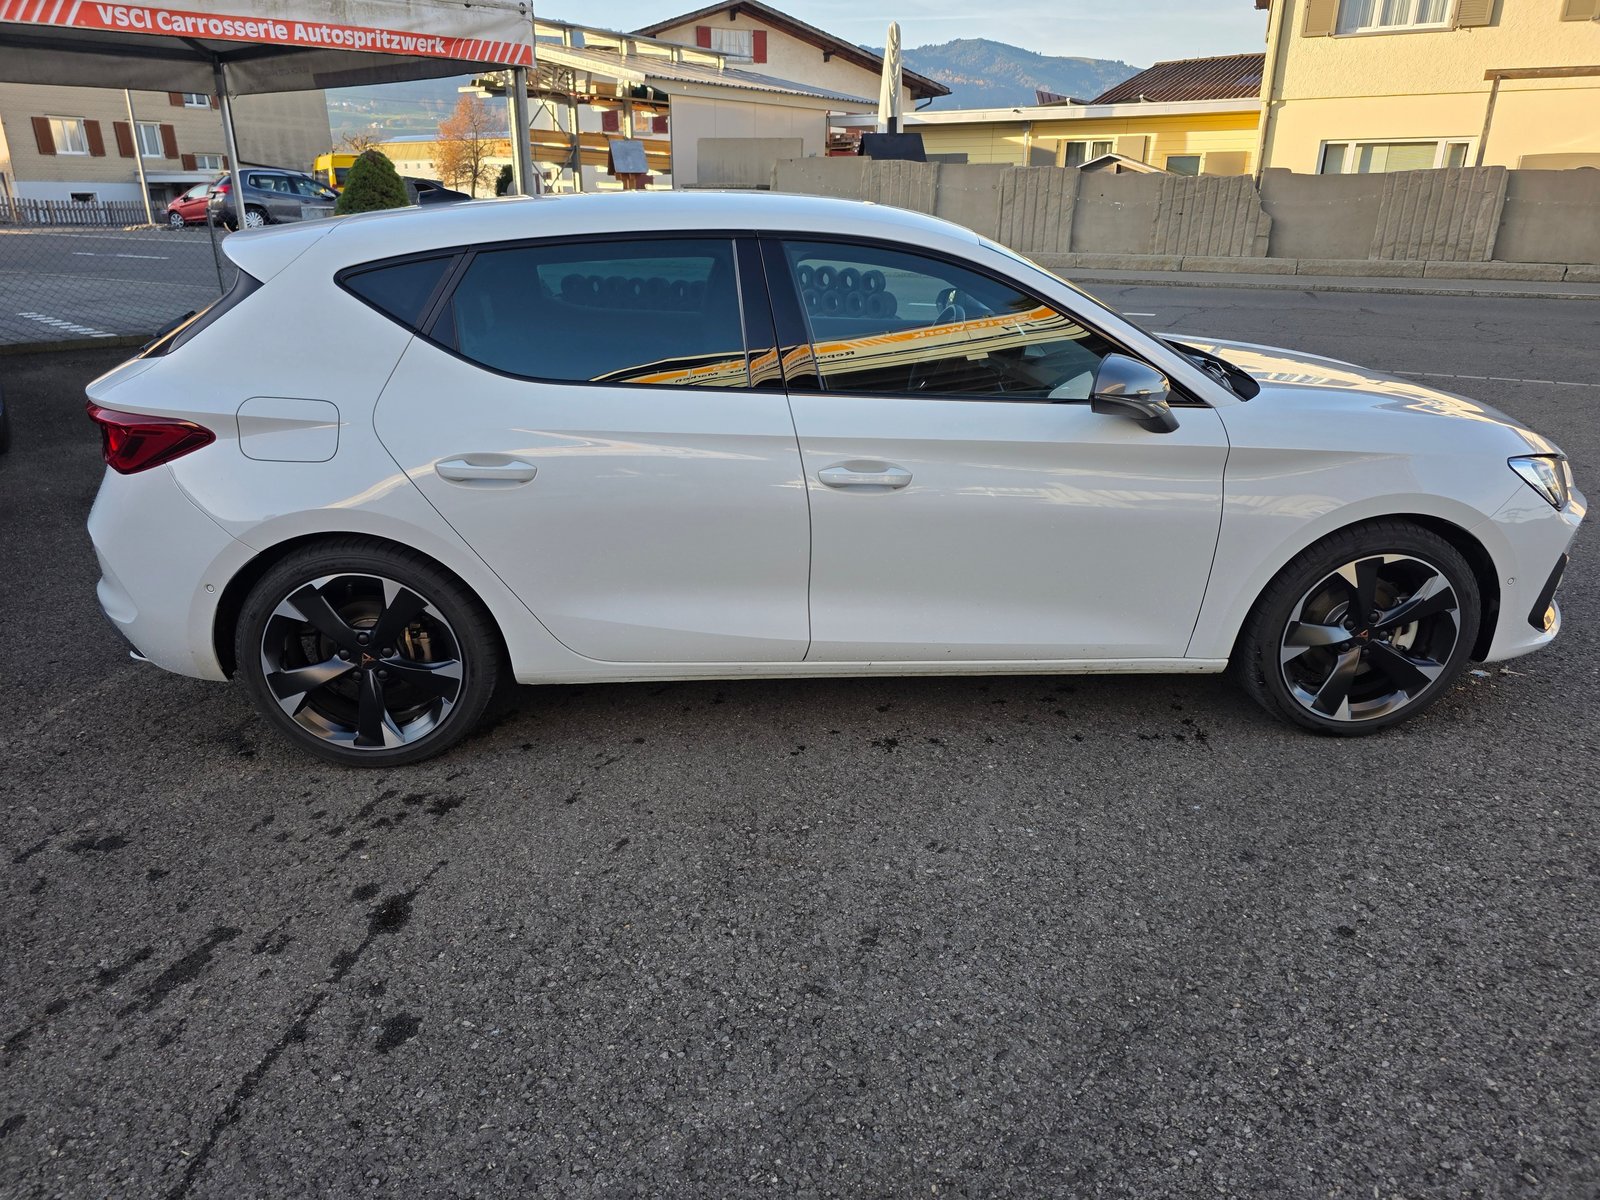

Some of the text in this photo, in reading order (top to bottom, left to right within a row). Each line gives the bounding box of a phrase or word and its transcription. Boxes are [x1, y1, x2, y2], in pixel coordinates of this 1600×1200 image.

[96, 4, 446, 54] VSCI Carrosserie Autospritzwerk
